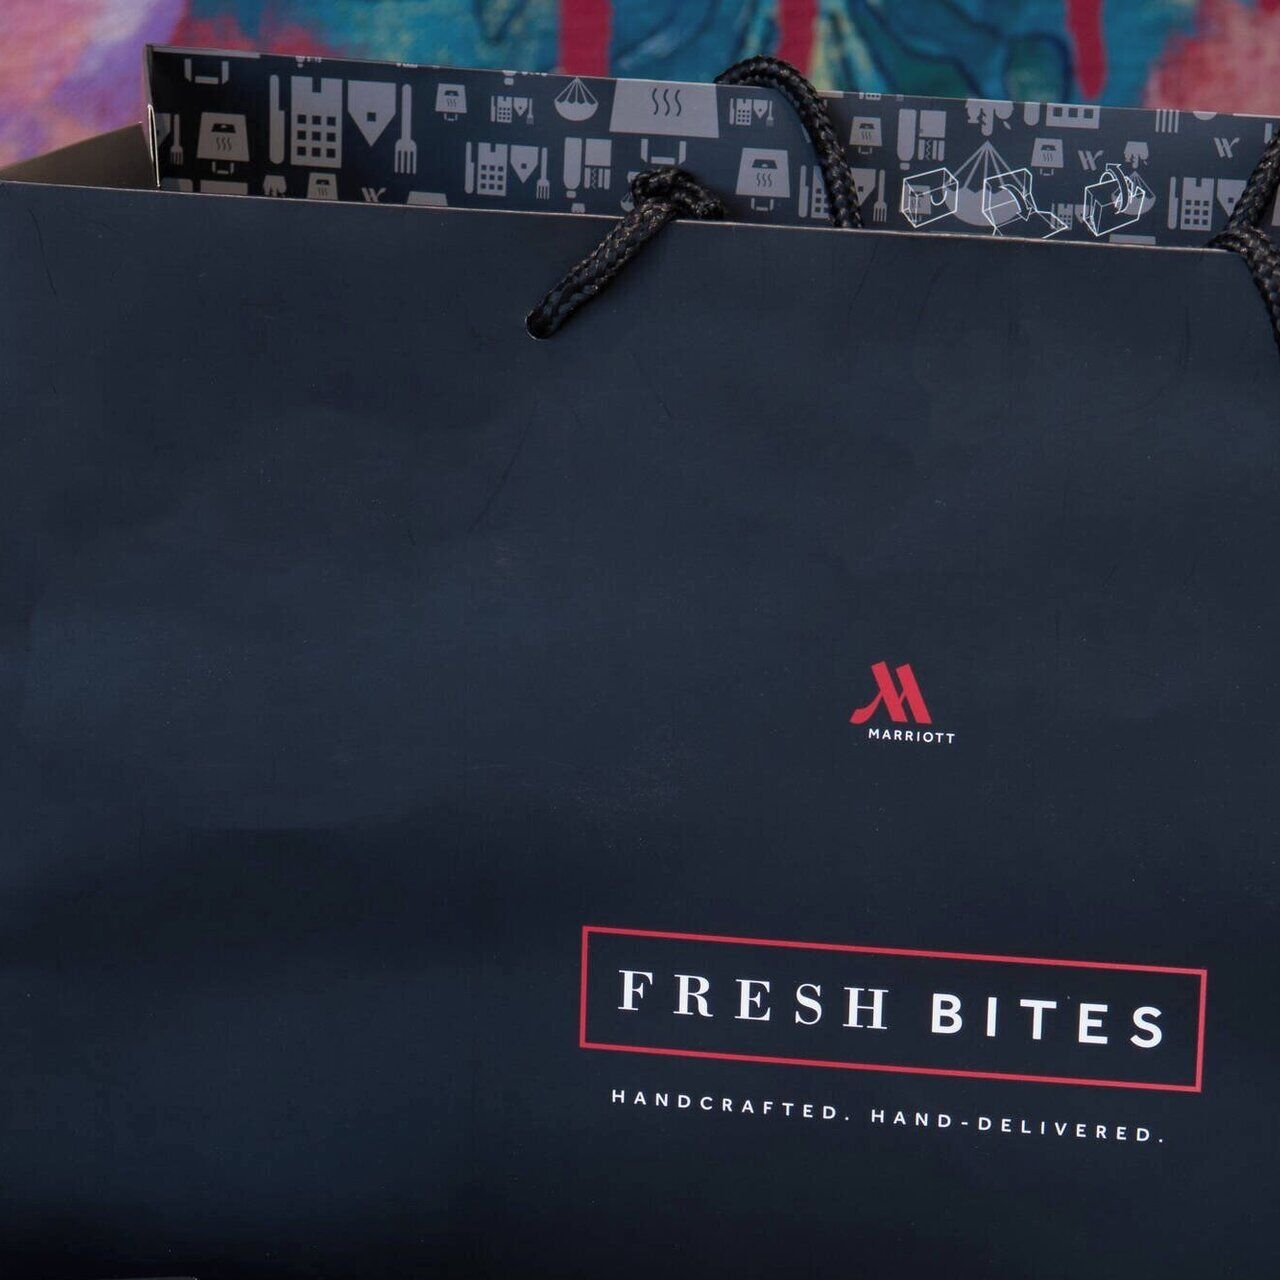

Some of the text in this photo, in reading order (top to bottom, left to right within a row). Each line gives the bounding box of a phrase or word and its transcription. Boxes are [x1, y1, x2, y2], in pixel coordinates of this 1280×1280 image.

[868, 728, 956, 744] MARRIOTT
[617, 969, 1163, 1050] FRESH BITES
[612, 1089, 1164, 1144] HANDCRAFTED. HAND-DELIVERED.
